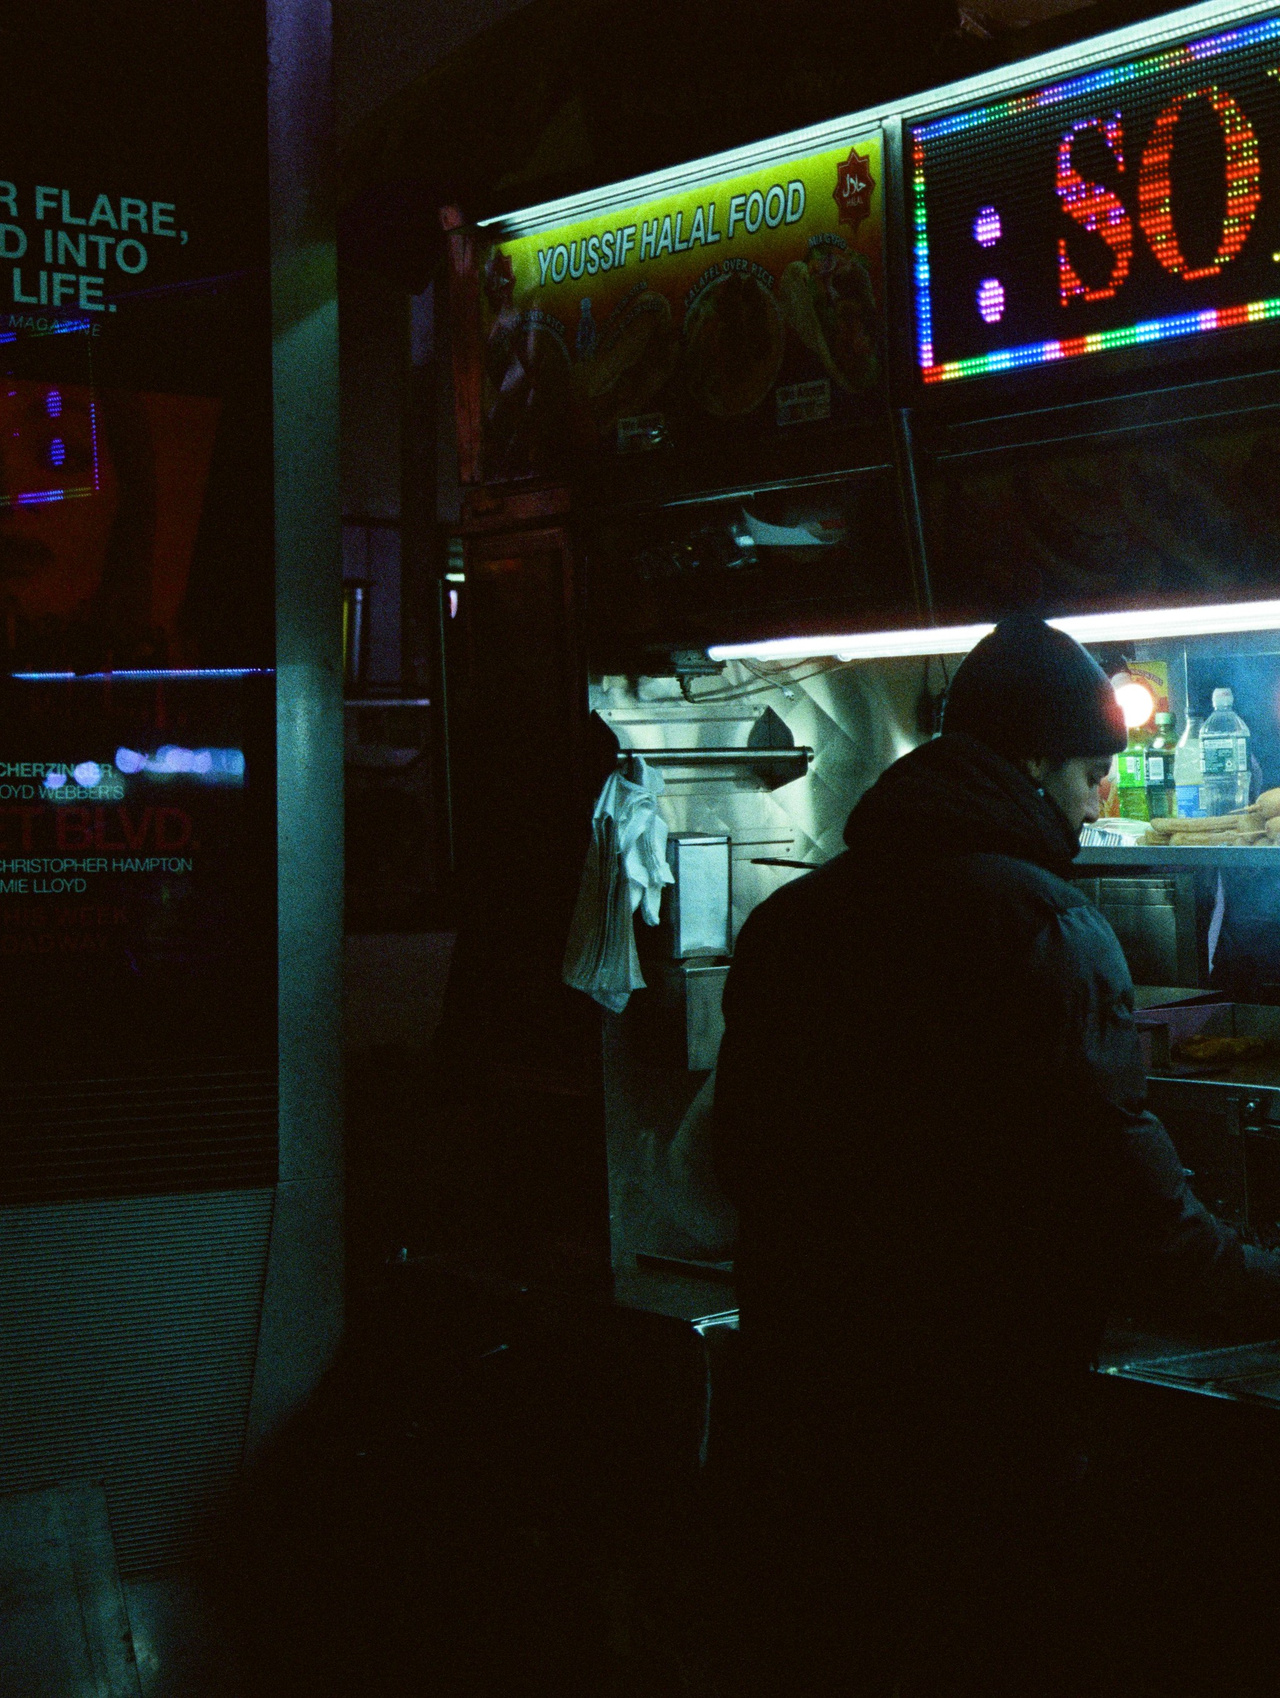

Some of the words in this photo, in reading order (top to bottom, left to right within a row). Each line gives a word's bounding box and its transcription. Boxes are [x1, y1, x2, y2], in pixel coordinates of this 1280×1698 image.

[35, 184, 189, 245] FLARE,
[536, 225, 638, 288] YOUSSIF
[638, 201, 722, 262] HALAL
[726, 179, 807, 239] FOOD
[44, 229, 149, 275] INTO
[12, 267, 118, 313] LIFE.
[38, 783, 126, 800] WEBBER'S
[55, 805, 201, 851] BLVD.
[32, 877, 88, 894] LLOYD
[111, 857, 193, 873] HAMPTON
